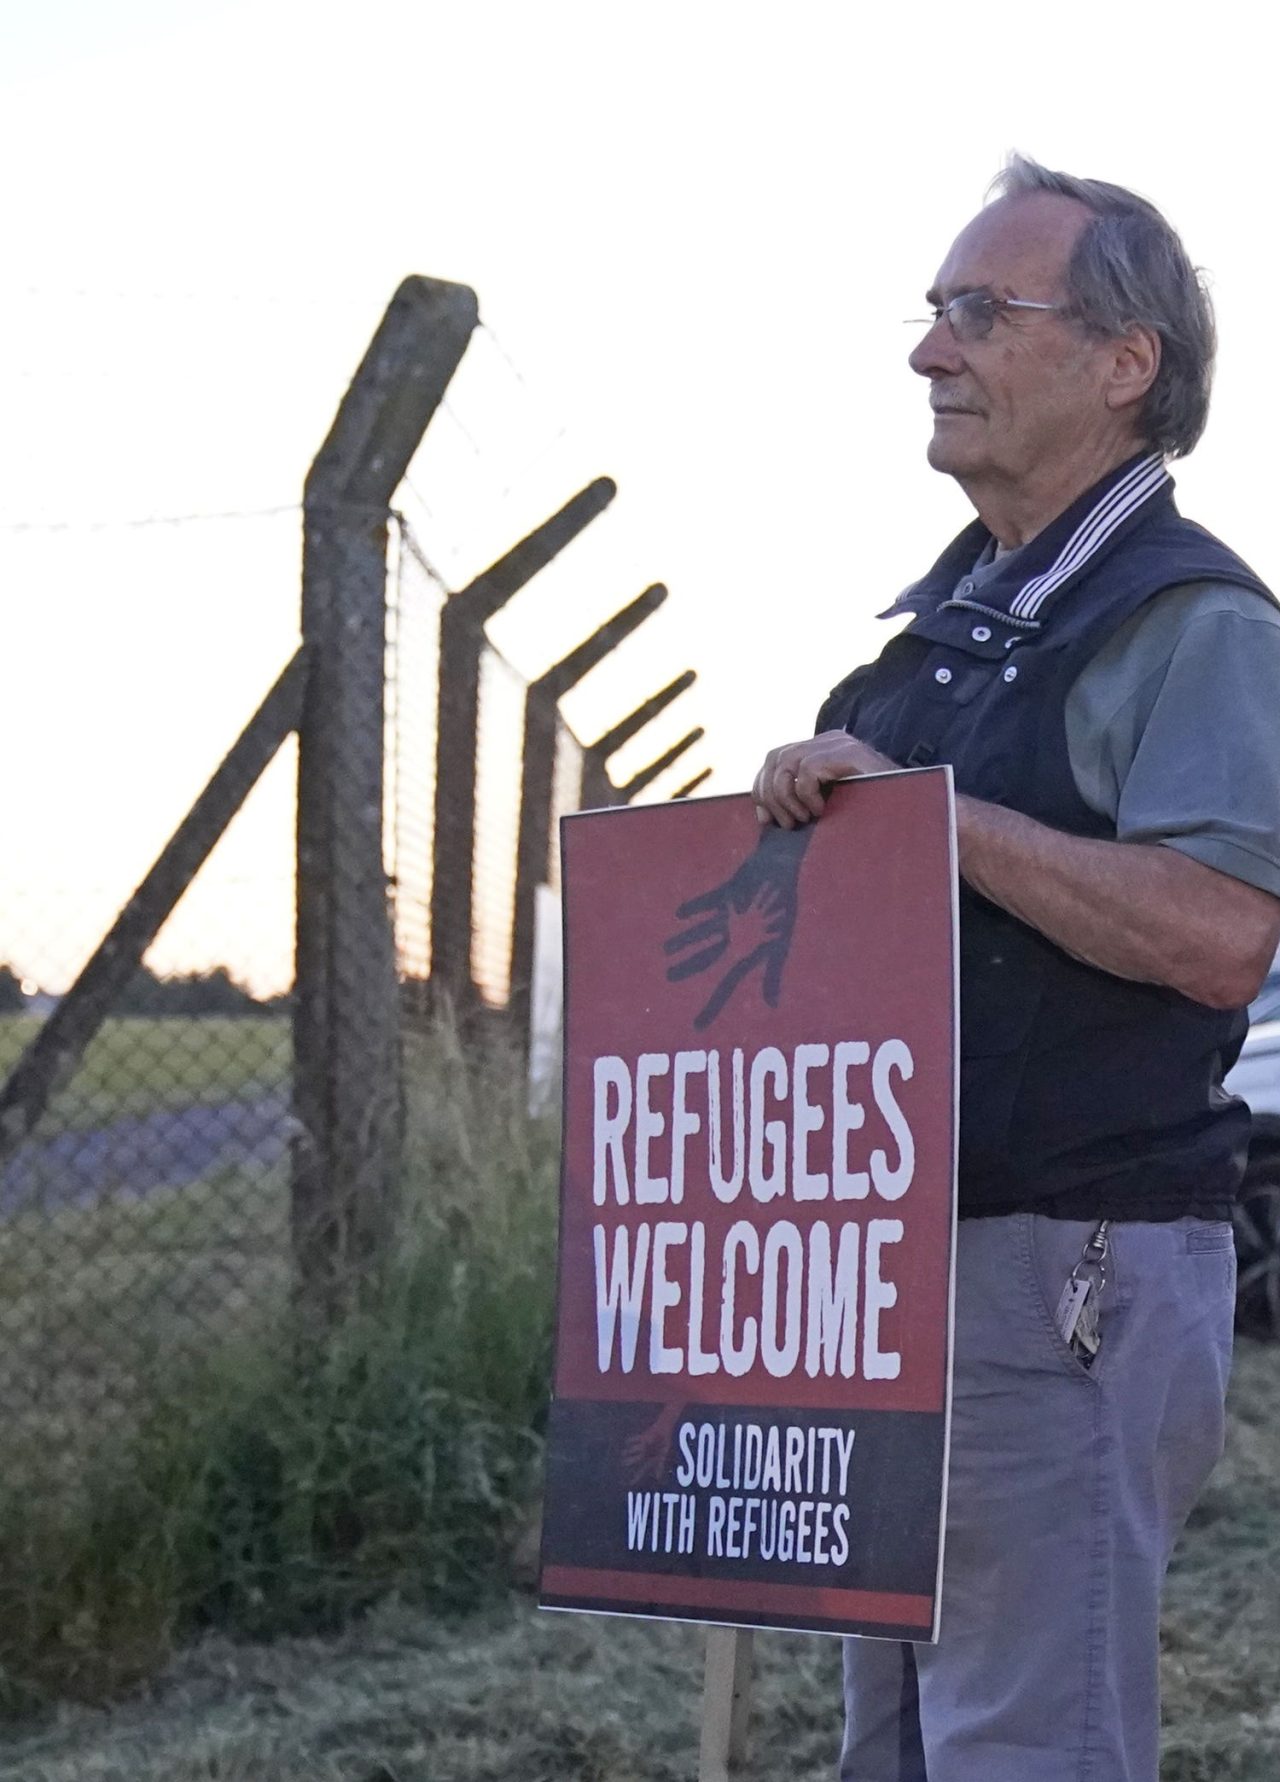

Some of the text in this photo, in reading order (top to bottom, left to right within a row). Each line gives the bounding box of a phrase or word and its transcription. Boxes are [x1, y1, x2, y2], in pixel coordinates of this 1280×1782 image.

[594, 1039, 915, 1206] REFUGEES
[594, 1219, 905, 1381] WELCOME
[677, 1422, 855, 1496] SOLIDARITY
[628, 1492, 851, 1566] WITH REFUGEES
